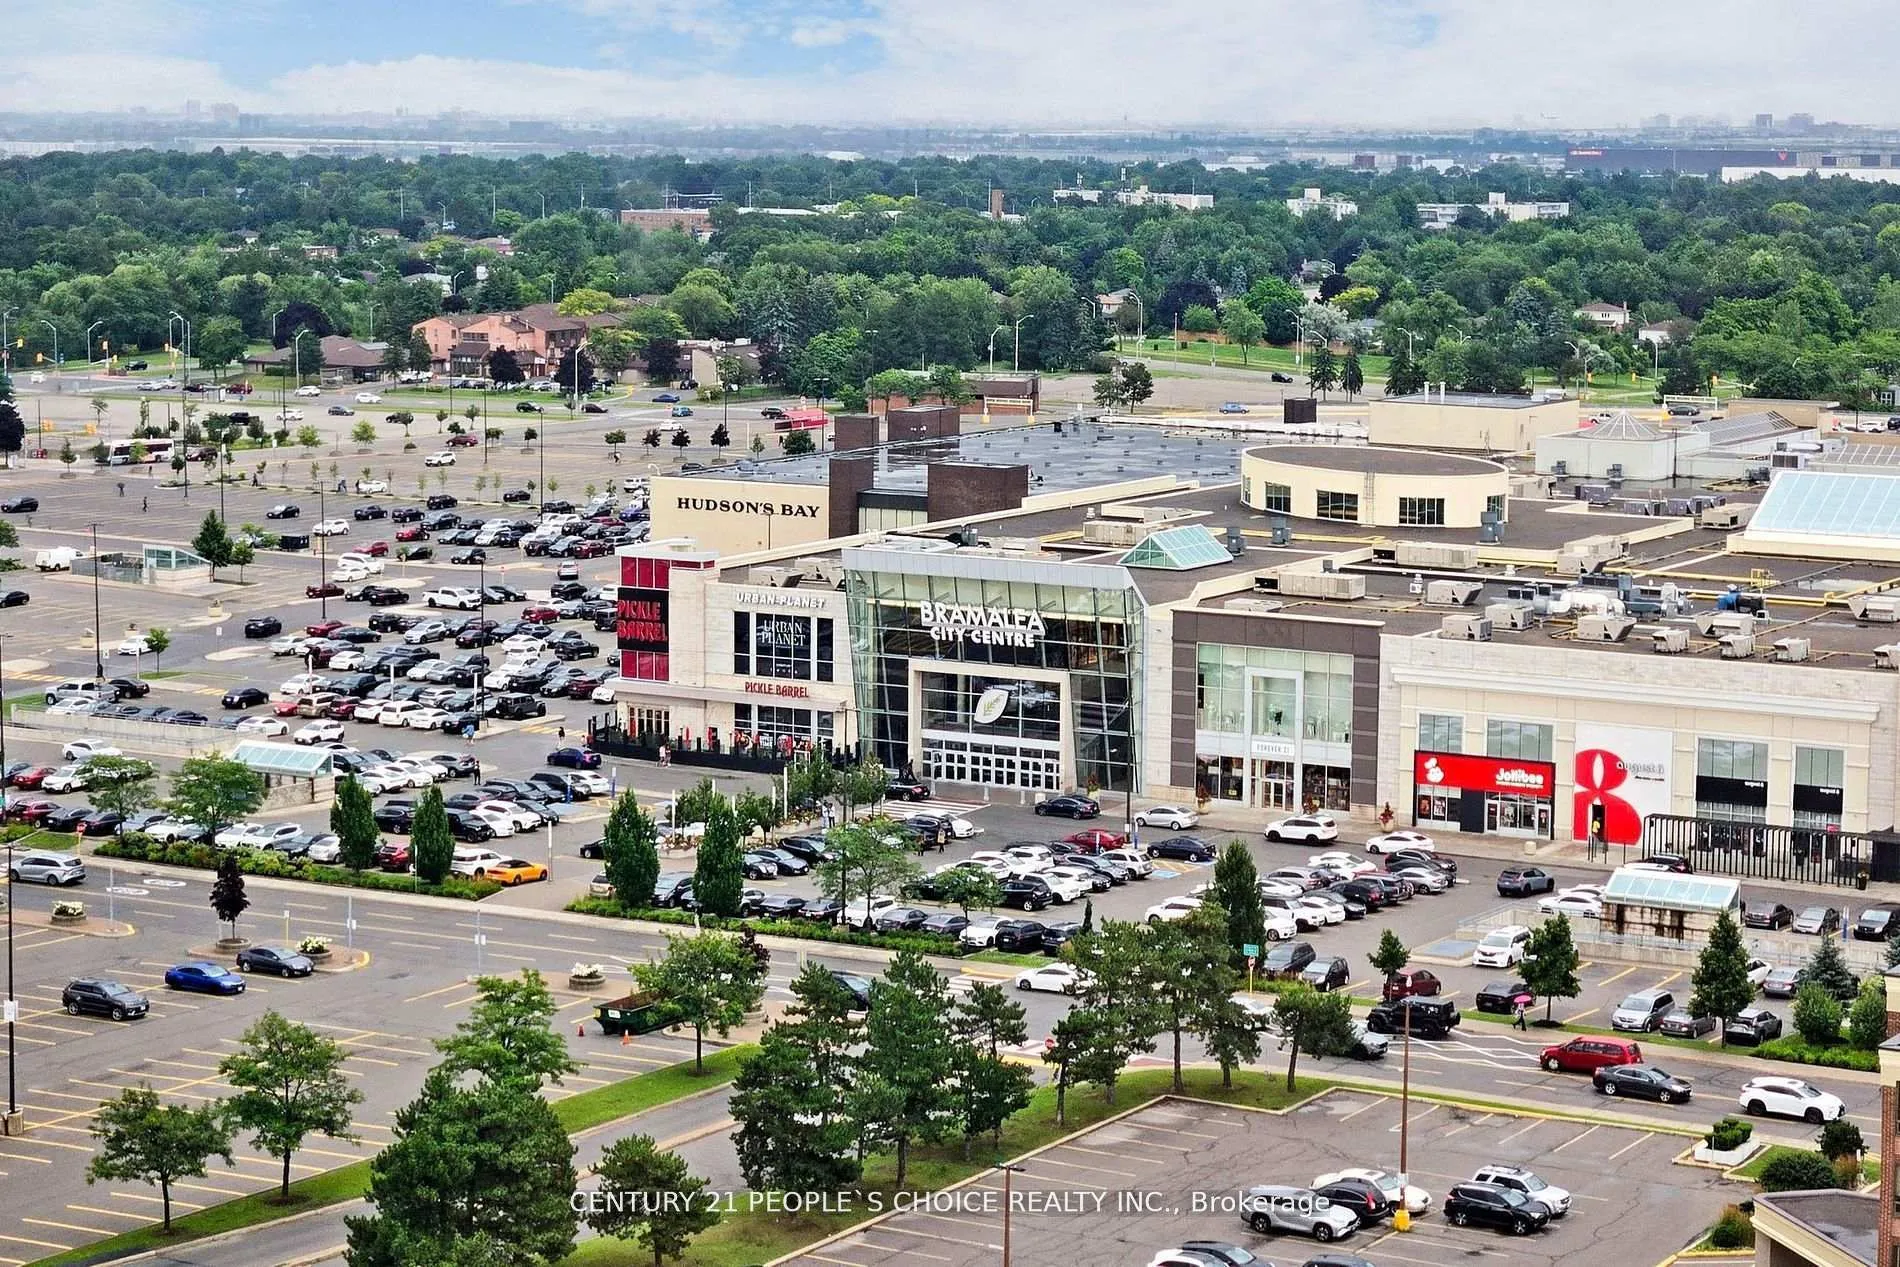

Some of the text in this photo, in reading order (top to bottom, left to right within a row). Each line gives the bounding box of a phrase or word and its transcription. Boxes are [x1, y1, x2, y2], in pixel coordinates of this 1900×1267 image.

[677, 497, 820, 518] HUDSON'S BAY
[617, 599, 661, 621] PICKLE
[737, 591, 825, 608] URBAN PLANET
[764, 619, 803, 634] URBAN
[920, 600, 1046, 636] BRAMALEA
[617, 620, 667, 642] BARREL
[761, 631, 806, 646] PLANET
[930, 626, 1035, 648] CITY CENTRE
[745, 681, 809, 698] PICKLE BARREL
